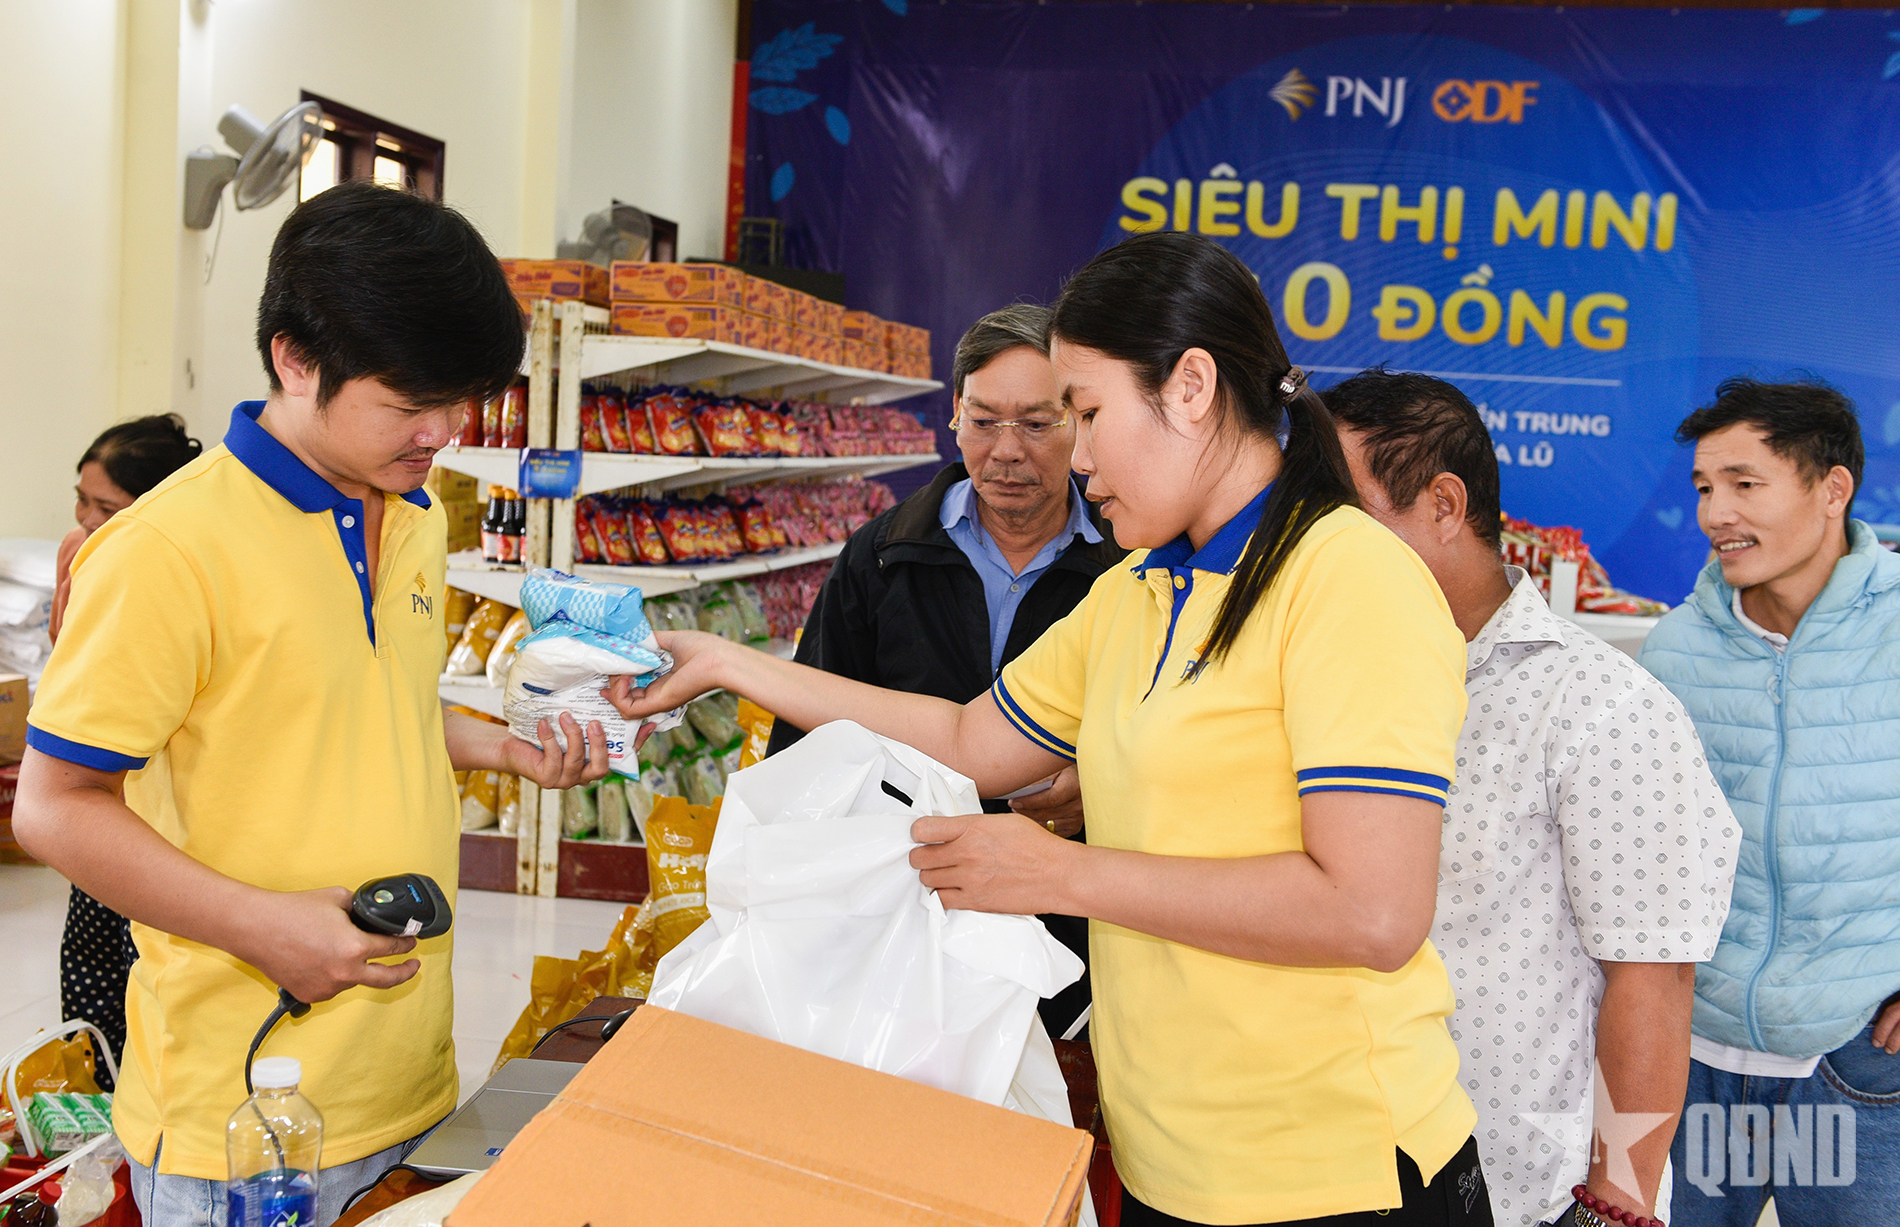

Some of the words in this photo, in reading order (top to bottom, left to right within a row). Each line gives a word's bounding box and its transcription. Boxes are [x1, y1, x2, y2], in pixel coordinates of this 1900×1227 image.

[1324, 75, 1407, 127] PNJ
[1119, 163, 1300, 239] SIÊU
[1325, 183, 1465, 260] THỊ
[1493, 187, 1679, 252] MINI
[1283, 261, 1352, 341] 0
[1371, 264, 1629, 351] ĐỒNG
[1514, 410, 1611, 437] TRUNG
[1518, 440, 1554, 468] LŨ
[411, 593, 433, 620] PNJ
